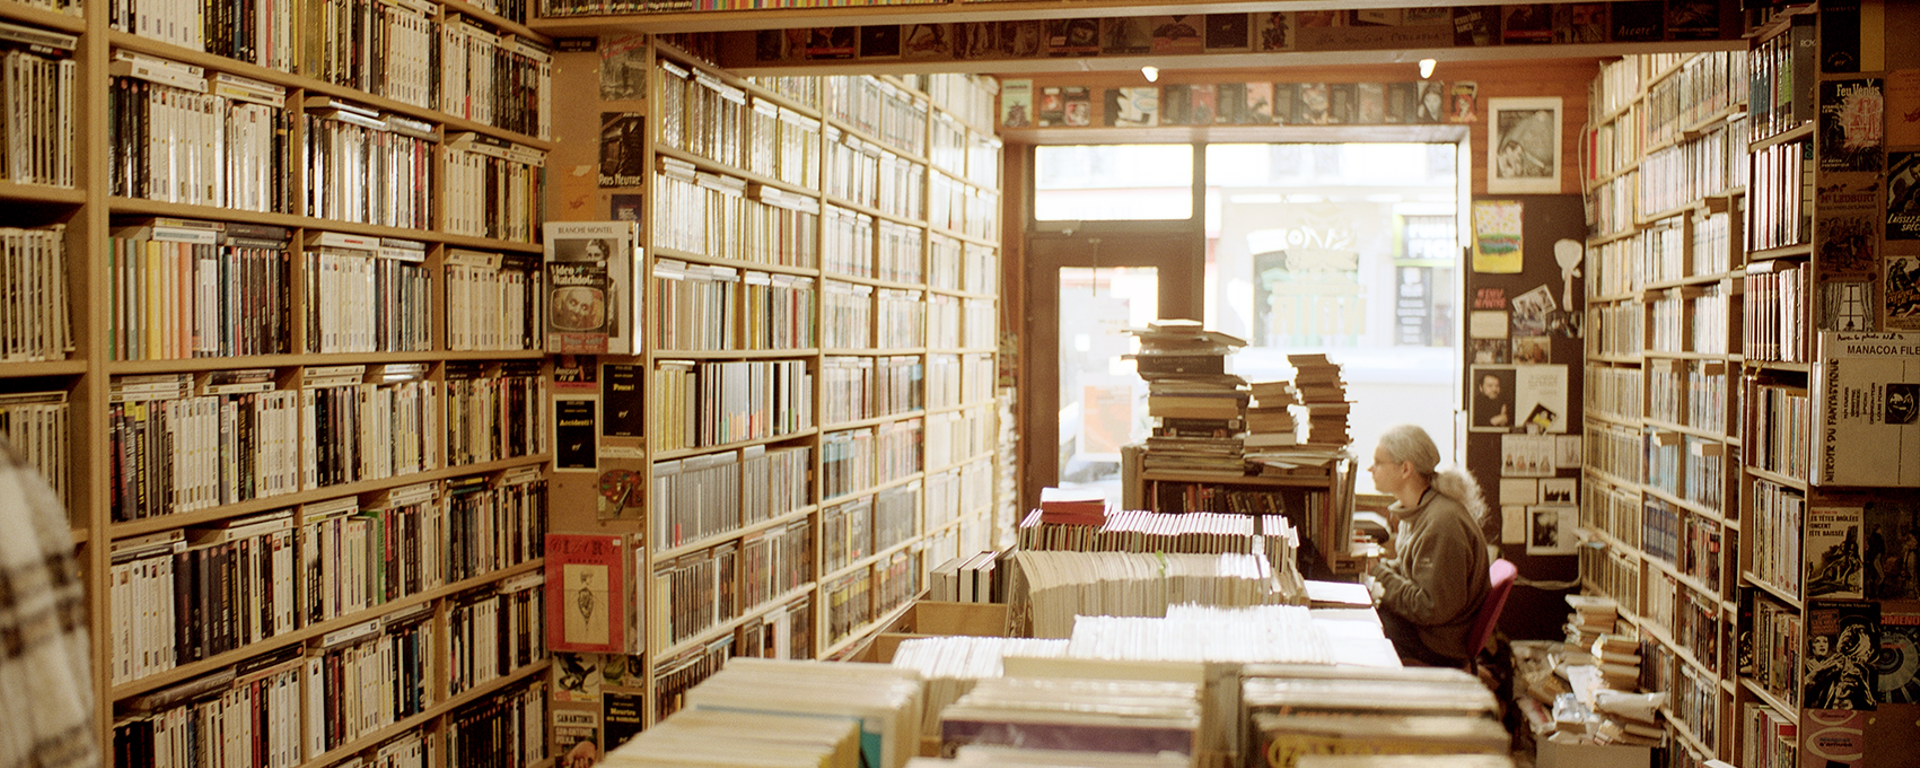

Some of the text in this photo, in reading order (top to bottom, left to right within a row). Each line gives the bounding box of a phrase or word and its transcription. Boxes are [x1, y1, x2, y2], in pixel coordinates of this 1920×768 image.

[1836, 84, 1851, 97] Feu
[1847, 345, 1898, 355] MANACOA
[1827, 359, 1840, 425] FANTASTIQUE
[1825, 444, 1836, 483] MIROIR
